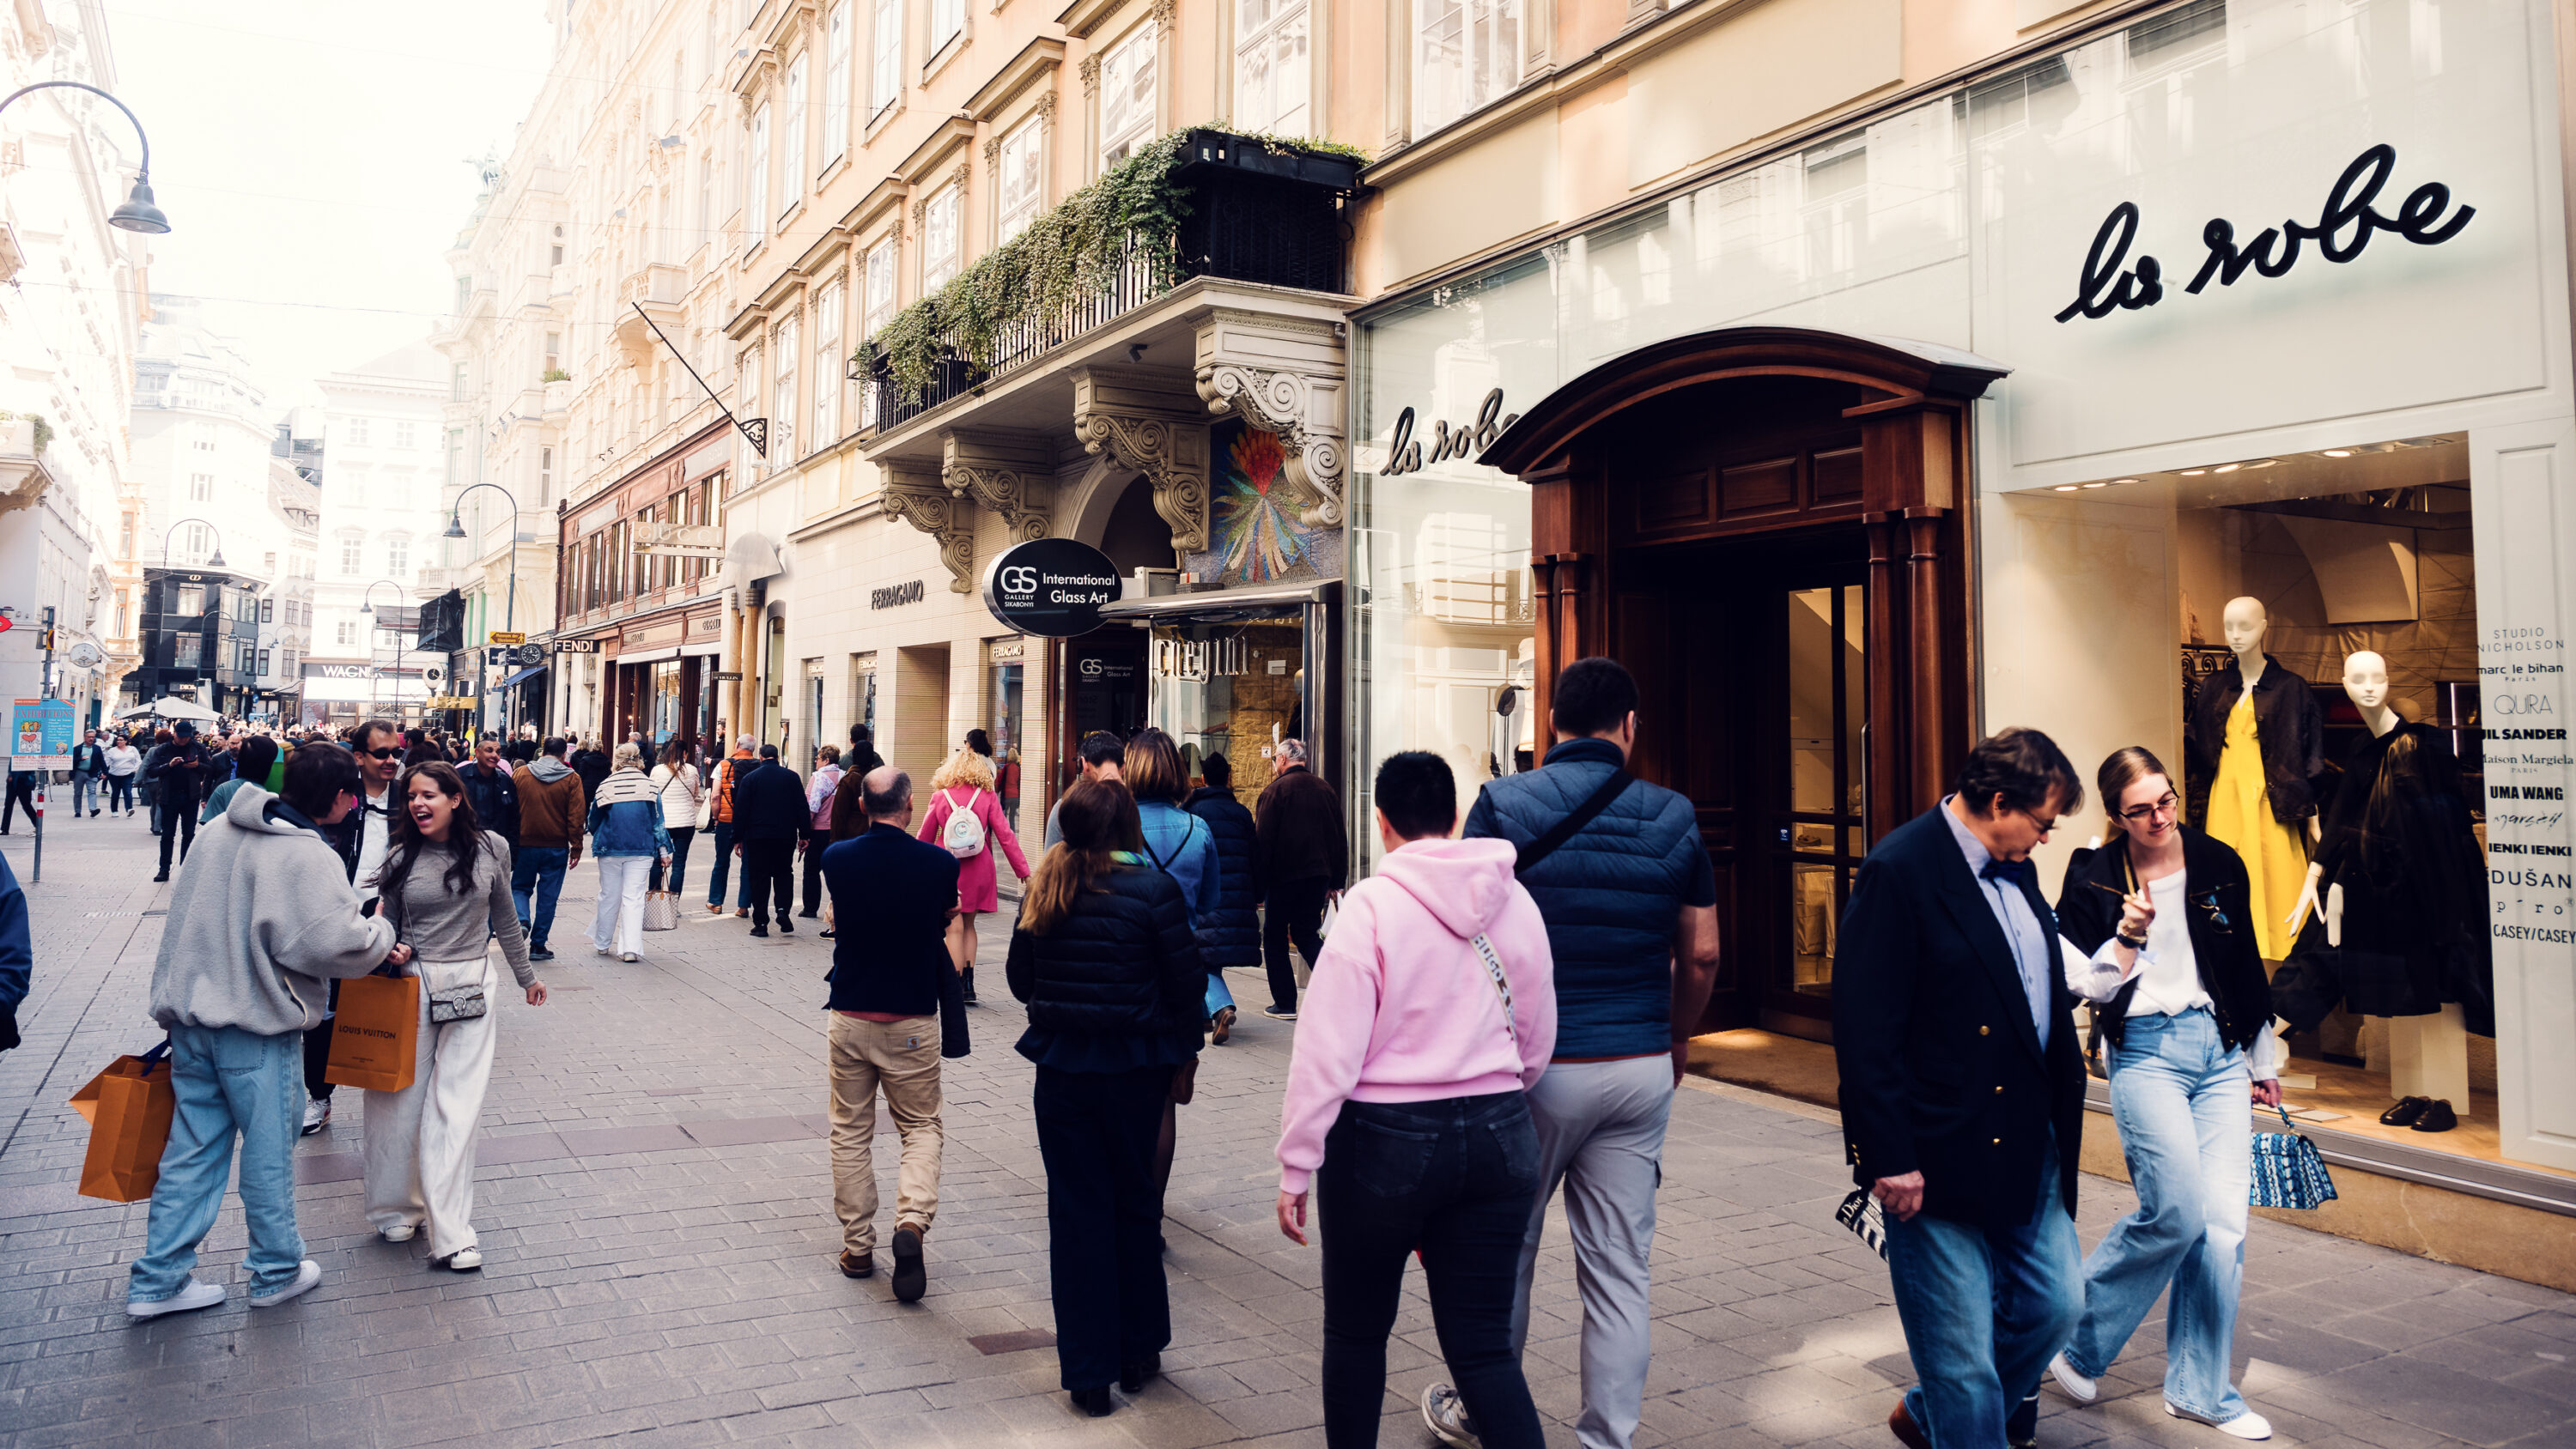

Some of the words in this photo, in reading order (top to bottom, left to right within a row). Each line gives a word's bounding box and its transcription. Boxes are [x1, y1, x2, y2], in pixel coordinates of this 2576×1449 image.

[2185, 143, 2476, 294] robe
[638, 525, 720, 544] GUCCI
[1000, 566, 1037, 594] GS
[1042, 573, 1115, 585] International
[871, 579, 924, 609] FERRAGAMO
[1050, 590, 1086, 603] Glass
[1089, 591, 1109, 603] Art
[2493, 627, 2544, 640] STUDIO
[554, 640, 593, 652] FENDI
[993, 645, 1022, 658] FERRAGAMO
[2477, 640, 2565, 652] NICHOLSON
[1079, 658, 1103, 675] GS
[2476, 666, 2507, 675] marc
[2512, 664, 2524, 674] le
[2528, 663, 2564, 674] bihan
[2502, 729, 2567, 740] SANDER
[2522, 754, 2574, 767] Margiela
[2490, 785, 2519, 799] UMA
[2522, 786, 2564, 800] WANG
[2488, 843, 2527, 854] IENKI
[2531, 845, 2572, 857] IENKI
[2491, 868, 2572, 888] DUŠAN
[2494, 925, 2576, 944] CASEY/CASEY
[338, 1024, 361, 1035] LOUIS
[362, 1028, 397, 1040] VUITTON
[1841, 1196, 1863, 1219] Dior
